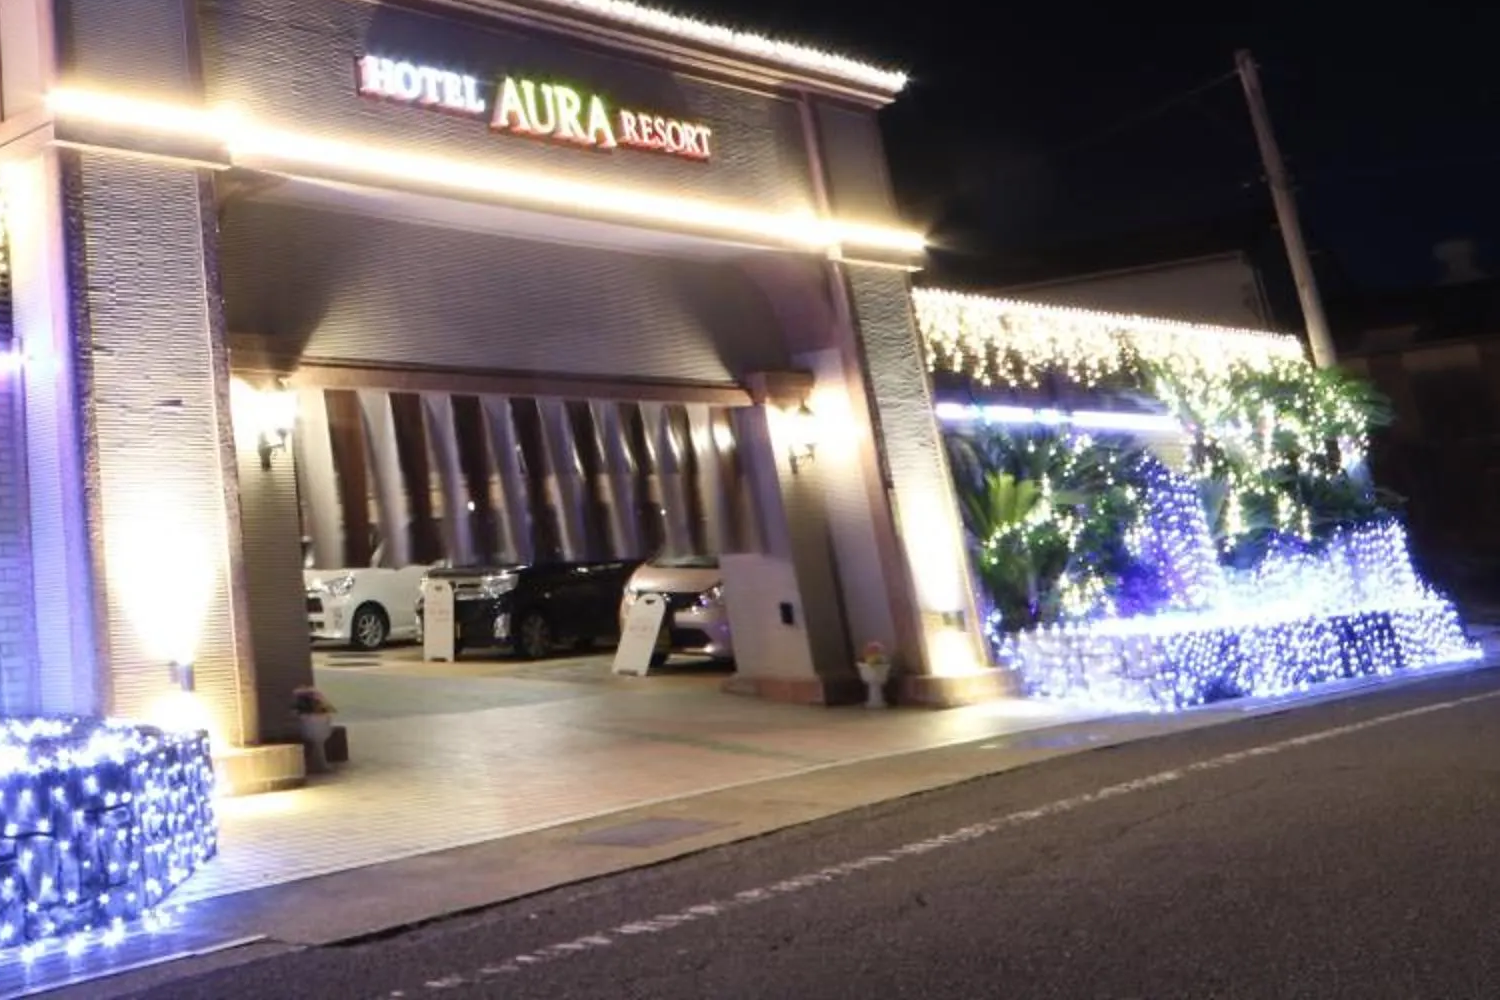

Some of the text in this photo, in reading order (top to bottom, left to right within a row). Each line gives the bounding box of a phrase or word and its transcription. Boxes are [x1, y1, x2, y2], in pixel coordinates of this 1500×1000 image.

[358, 55, 712, 159] HOTEL AURA RESORT
